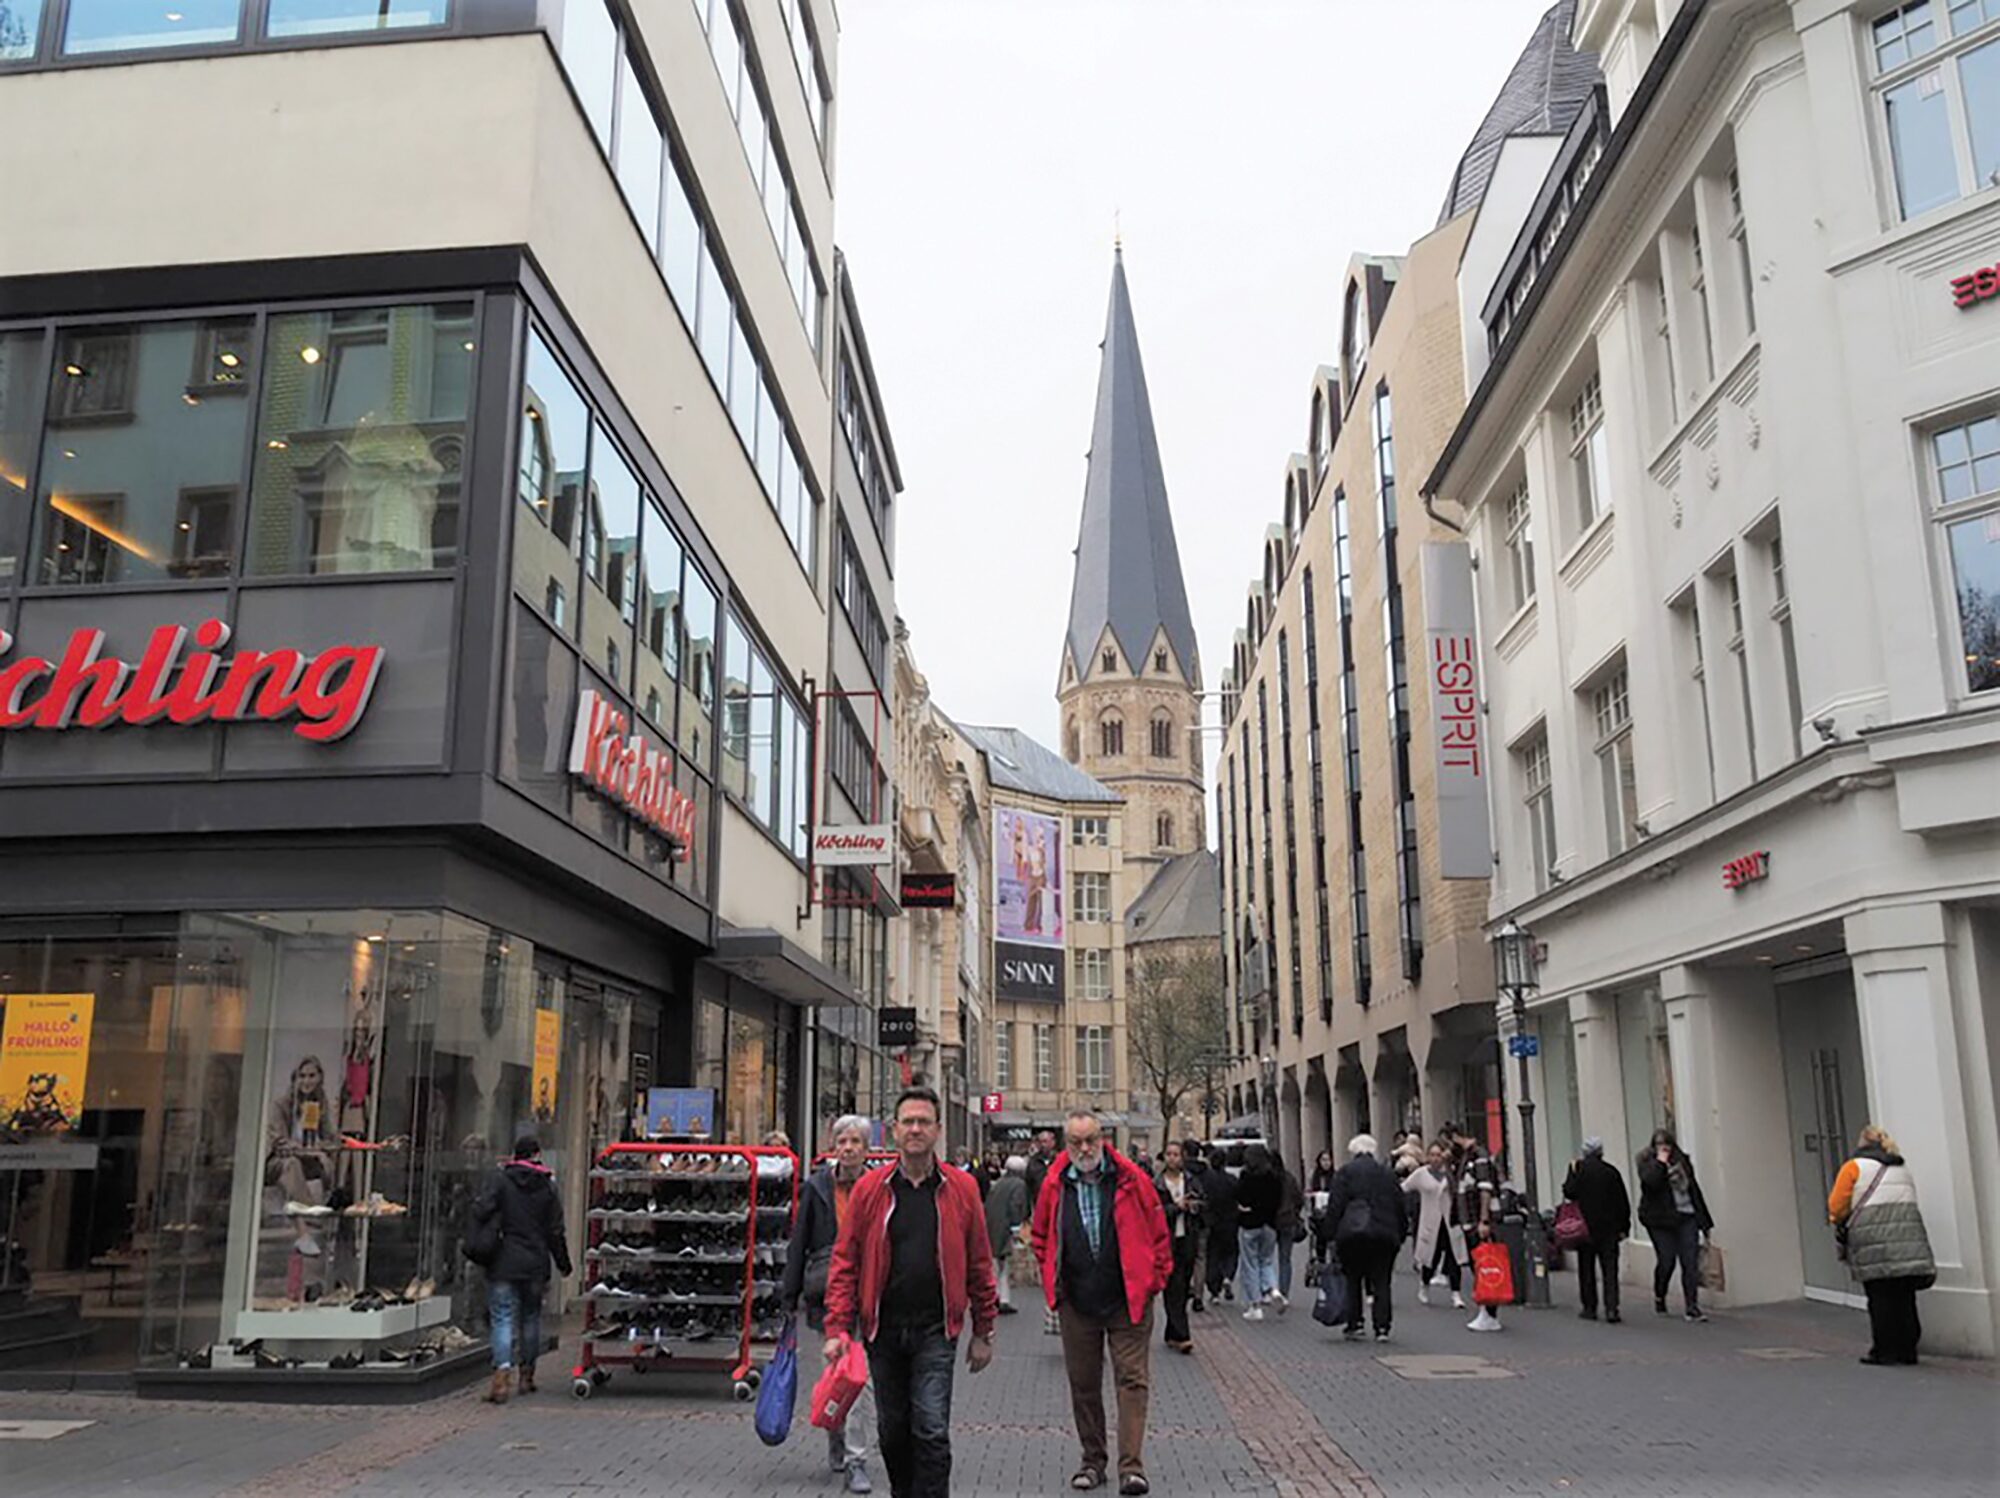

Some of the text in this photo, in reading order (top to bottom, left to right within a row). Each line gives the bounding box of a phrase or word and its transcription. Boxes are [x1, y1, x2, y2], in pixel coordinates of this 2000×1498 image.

[1950, 262, 2000, 309] ES
[0, 619, 385, 743] chling
[1435, 637, 1479, 777] ESPRIT
[816, 834, 885, 850] Köchling
[24, 1021, 70, 1033] HALLO
[882, 1021, 914, 1032] zero
[7, 1034, 83, 1048] FRÜHLING!
